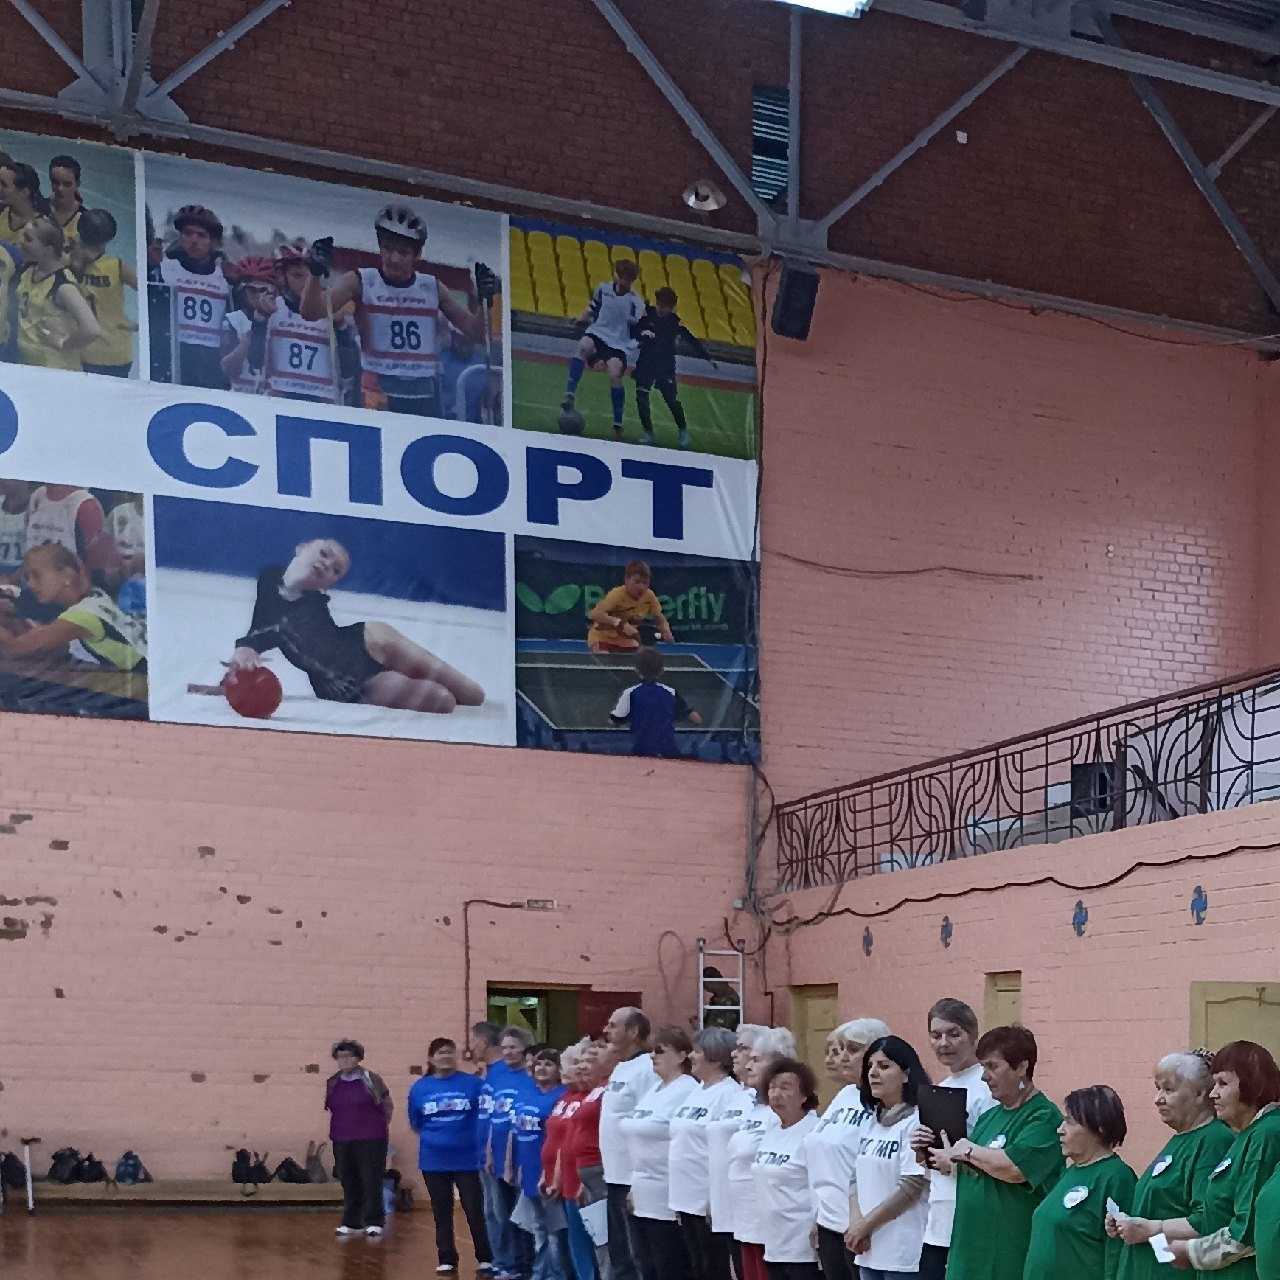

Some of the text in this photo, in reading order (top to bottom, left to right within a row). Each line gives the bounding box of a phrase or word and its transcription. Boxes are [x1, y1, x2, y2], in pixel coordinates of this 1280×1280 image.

[184, 295, 213, 323] 89
[390, 320, 422, 350] 86
[288, 342, 319, 371] 87
[146, 401, 714, 541] СПОРТ
[584, 585, 727, 623] Berfly
